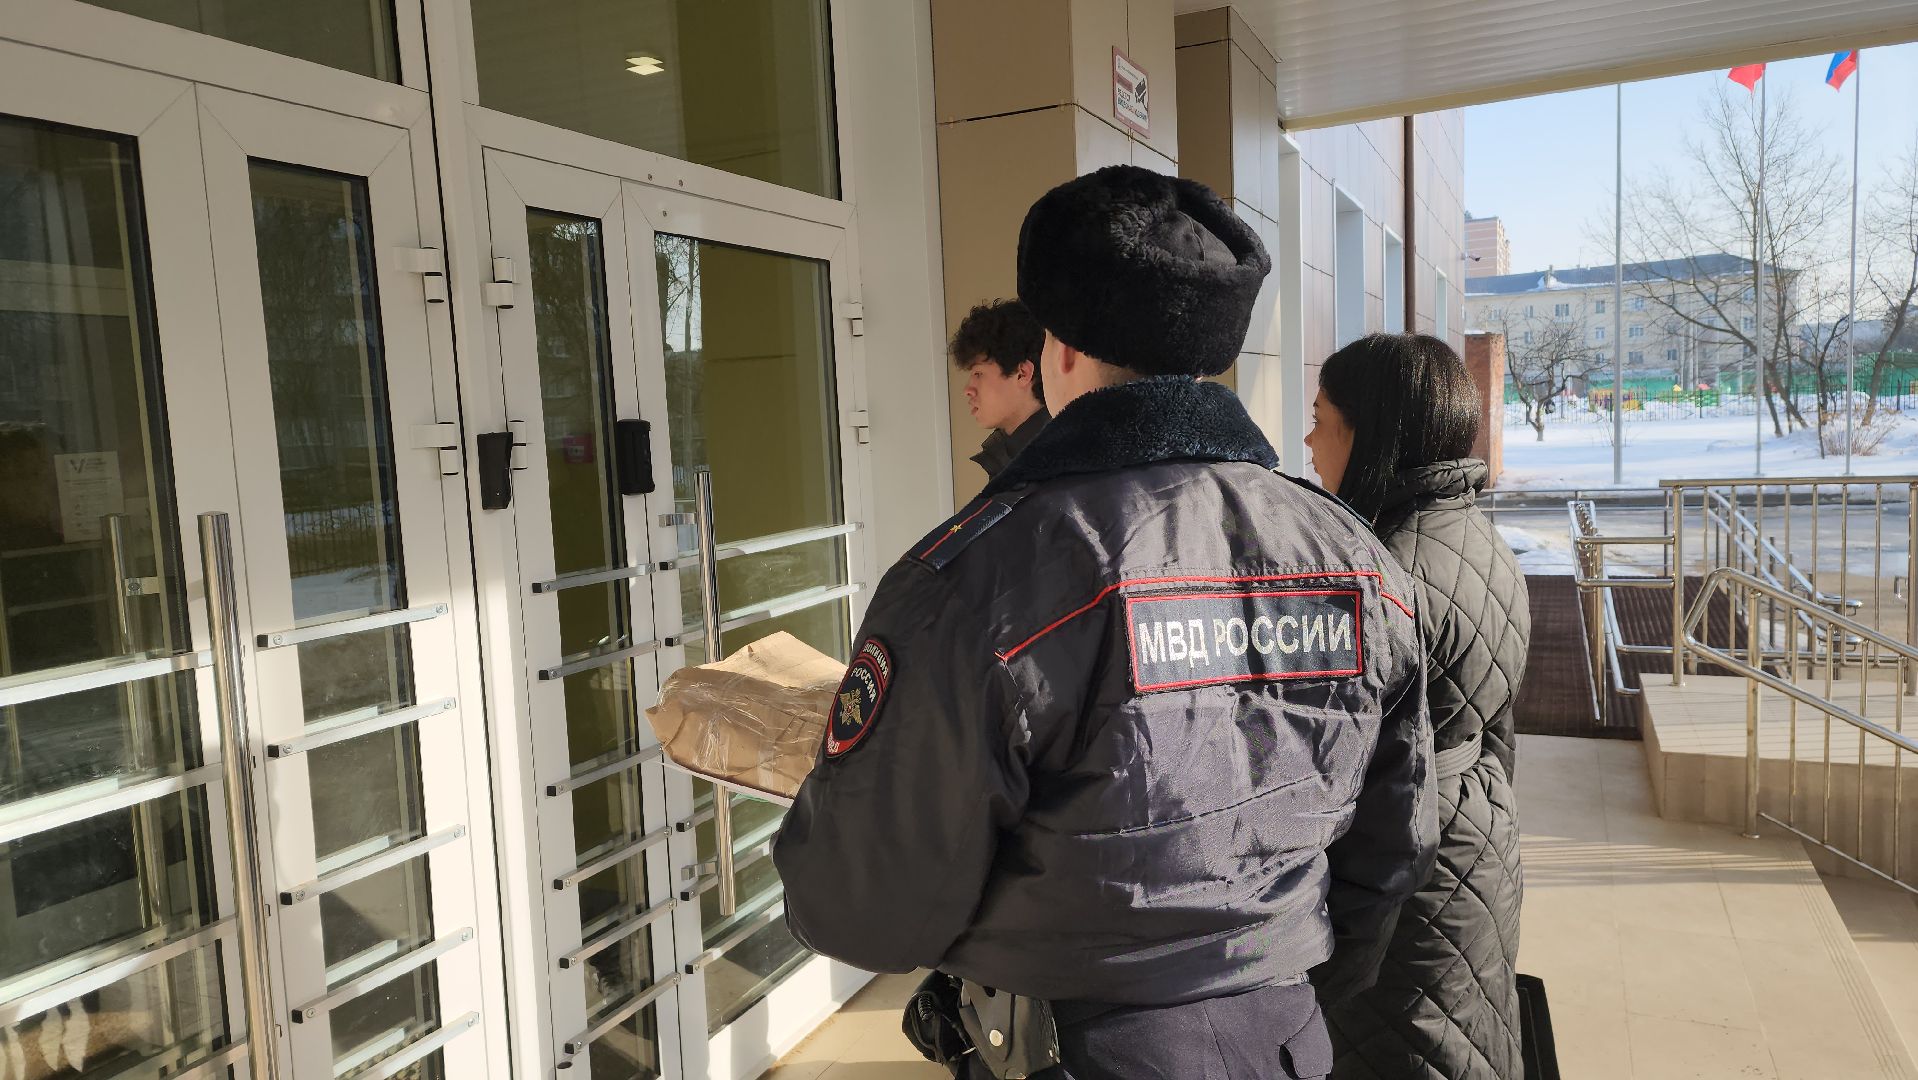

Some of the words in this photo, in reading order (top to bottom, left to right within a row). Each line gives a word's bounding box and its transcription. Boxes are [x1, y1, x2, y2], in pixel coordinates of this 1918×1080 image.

[1138, 619, 1210, 668] МВД
[1212, 612, 1352, 658] РОССИИ
[862, 642, 889, 680] ПОЛИЦИЯ
[850, 666, 877, 703] РОССИЯ
